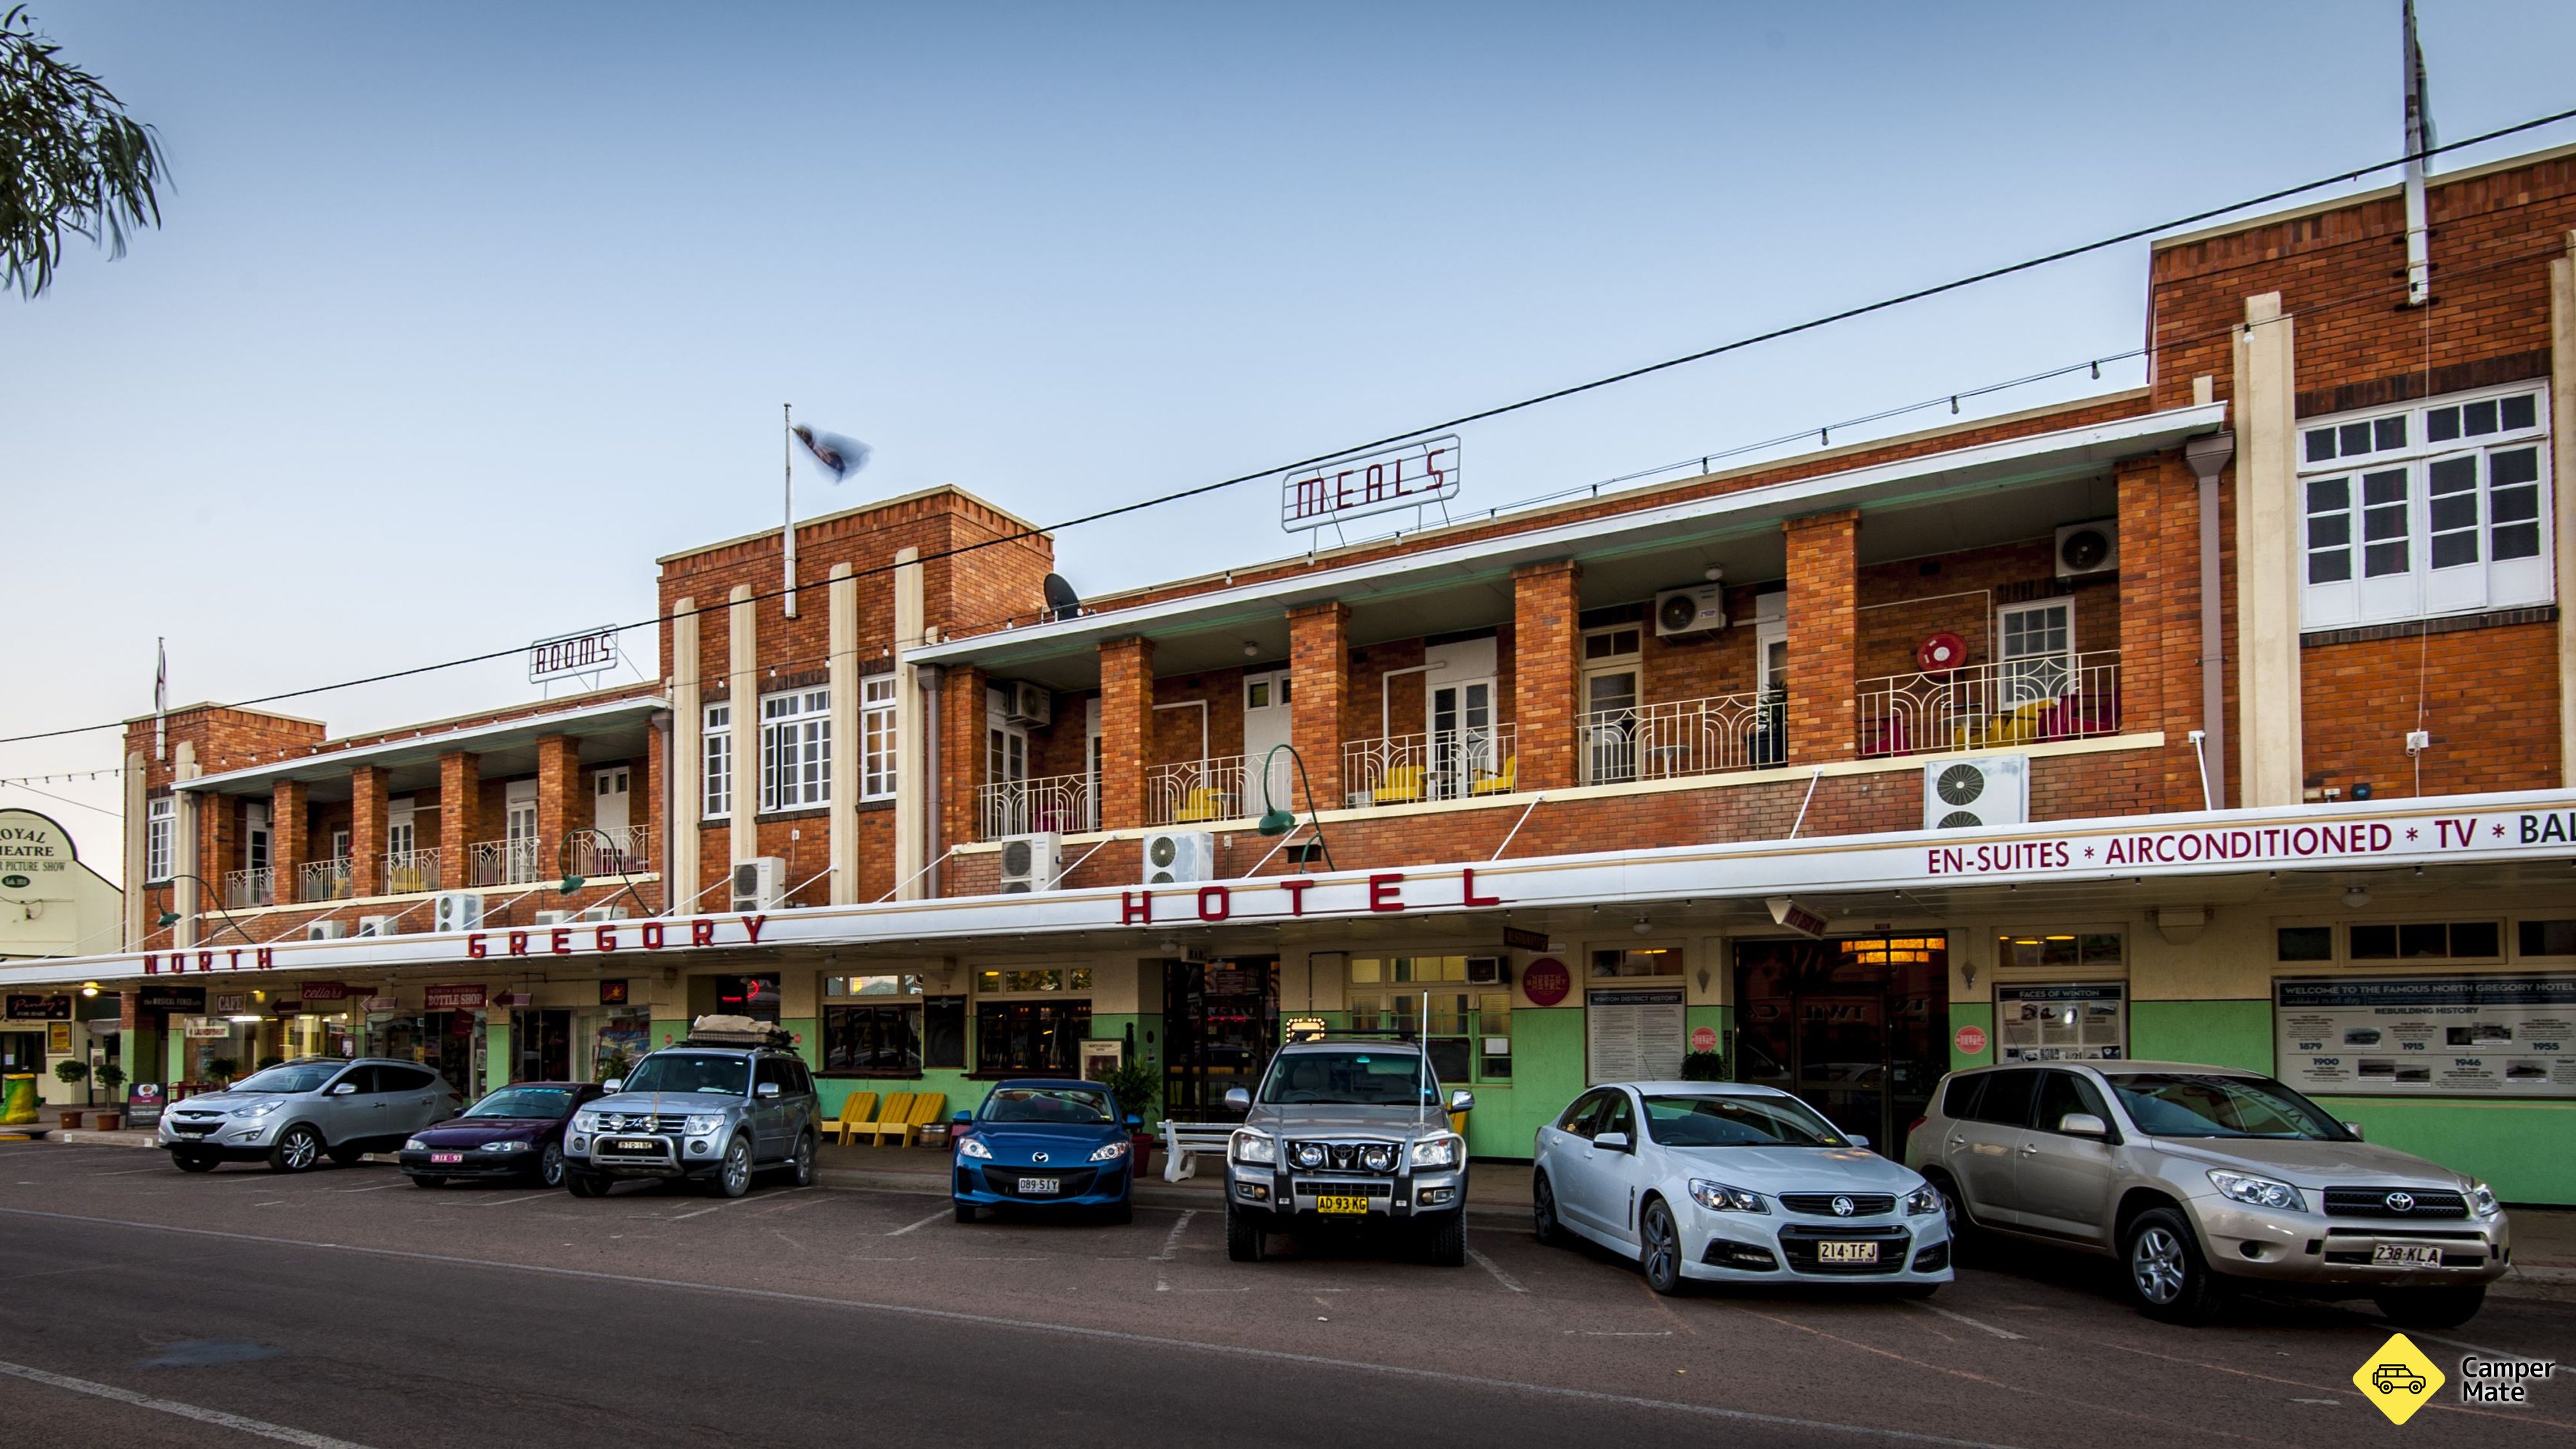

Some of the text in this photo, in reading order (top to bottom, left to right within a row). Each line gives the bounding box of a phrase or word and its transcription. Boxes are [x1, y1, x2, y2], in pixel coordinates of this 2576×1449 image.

[1296, 448, 1445, 518] MEALS
[536, 633, 610, 674] ROOMS
[0, 828, 46, 844] OYAL
[1928, 840, 2069, 875] EN-SUITES
[2105, 823, 2392, 864] AIRCONDITIONED
[2434, 818, 2477, 848] TV
[6, 861, 39, 871] PICTURE
[43, 862, 66, 871] SHOW
[1122, 867, 1500, 925] HOTEL
[468, 914, 766, 958] GREGORY
[144, 946, 273, 975] NORTH
[303, 987, 343, 999] cellars
[2285, 986, 2340, 995] WELCOME
[2342, 986, 2358, 994] TO
[2383, 985, 2430, 994] FAMOUS
[2432, 983, 2474, 992] NORTH
[2476, 983, 2533, 992] GREGORY
[2536, 982, 2575, 991] HOTEL
[218, 995, 243, 1011] CAFE
[428, 993, 483, 1006] BOTTLE SHOP
[2532, 1042, 2560, 1050] 1955
[2313, 1057, 2340, 1066] 1900
[2454, 1058, 2482, 1066] 1946
